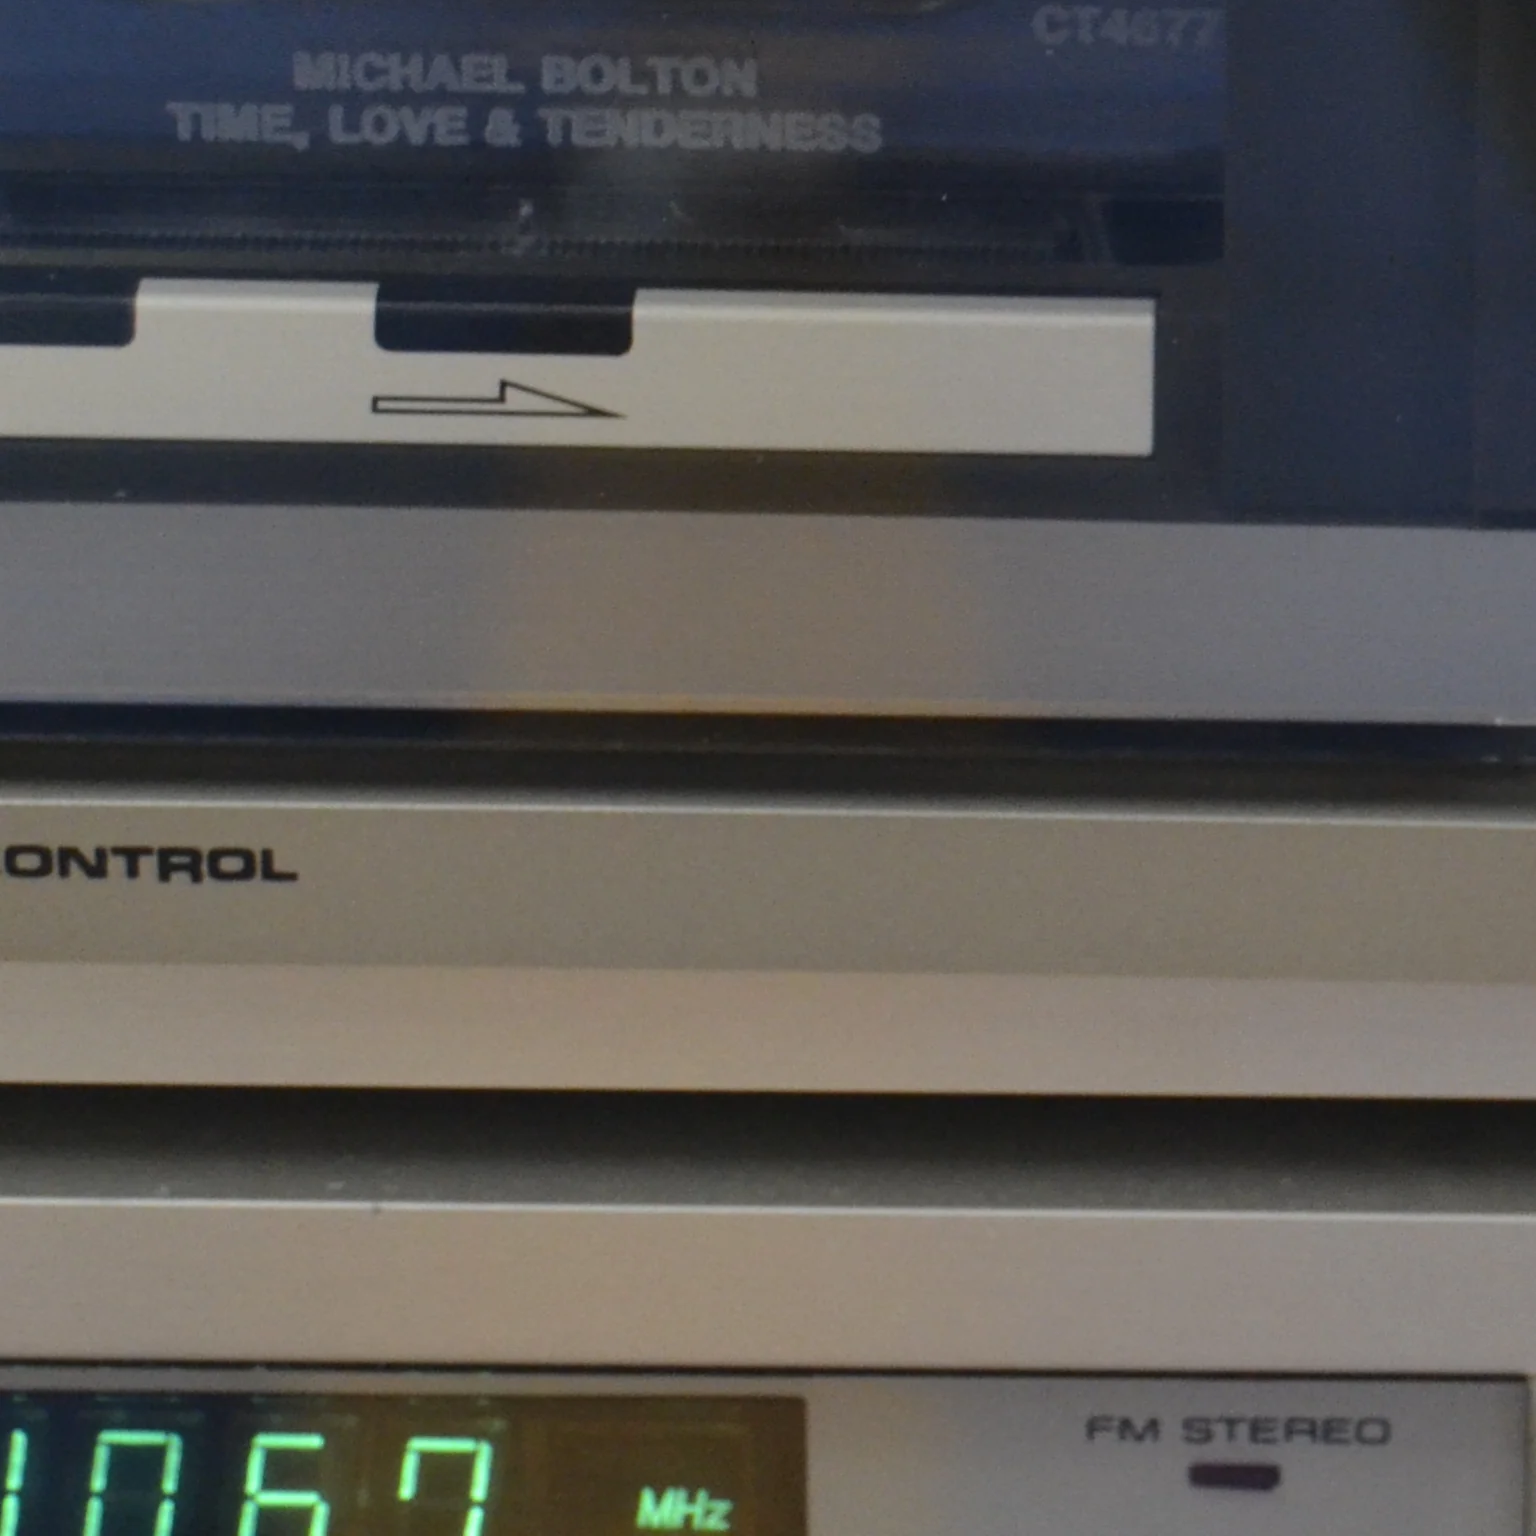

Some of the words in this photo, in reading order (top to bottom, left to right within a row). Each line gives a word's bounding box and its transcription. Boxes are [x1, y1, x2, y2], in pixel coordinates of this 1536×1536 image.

[293, 52, 525, 94] MICHAEL
[541, 54, 758, 97] BOLTON
[167, 102, 309, 150] TIME,
[329, 105, 469, 145] LOVE
[485, 106, 520, 147] &
[536, 106, 884, 152] TENDERNESS
[1085, 1415, 1161, 1443] FM
[1182, 1415, 1392, 1446] STEREO
[636, 1486, 733, 1532] MHz
